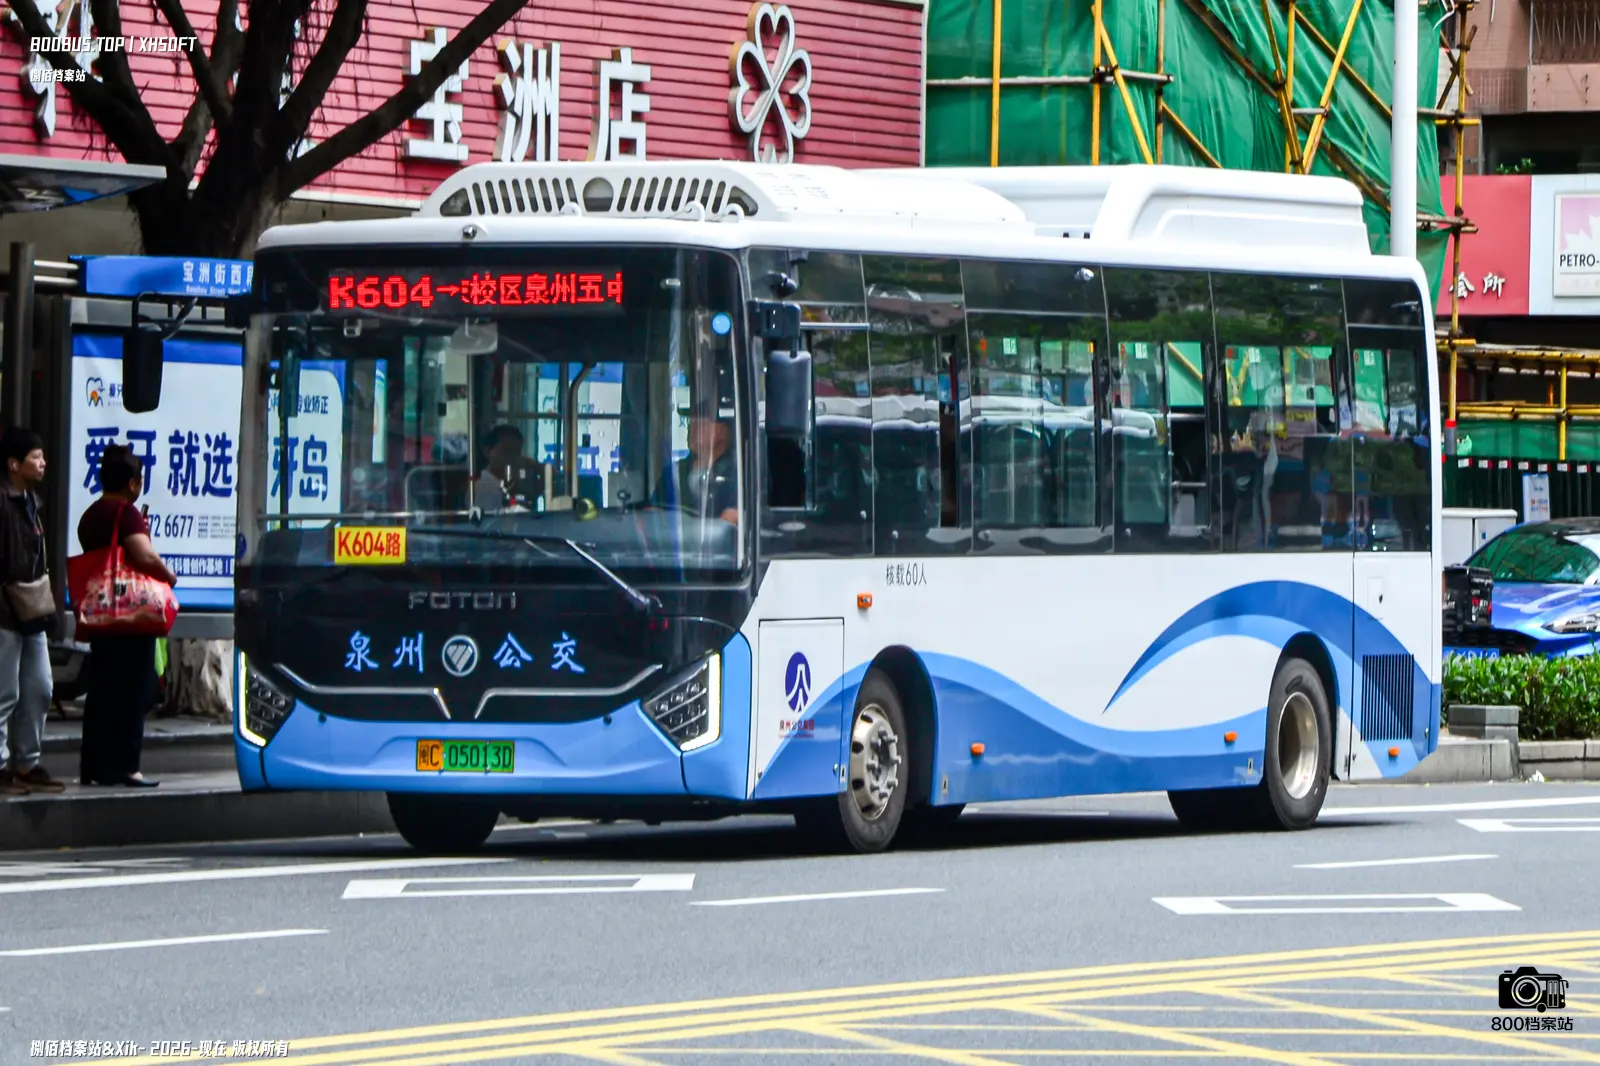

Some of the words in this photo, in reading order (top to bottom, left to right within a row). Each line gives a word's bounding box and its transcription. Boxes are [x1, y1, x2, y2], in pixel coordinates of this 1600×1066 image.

[329, 275, 434, 308] K604
[164, 514, 194, 538] 6677
[338, 531, 401, 558] K604路
[885, 563, 928, 587] 核载60人
[344, 629, 425, 674] 泉州
[493, 632, 586, 674] 公交
[447, 744, 513, 768] 05013D
